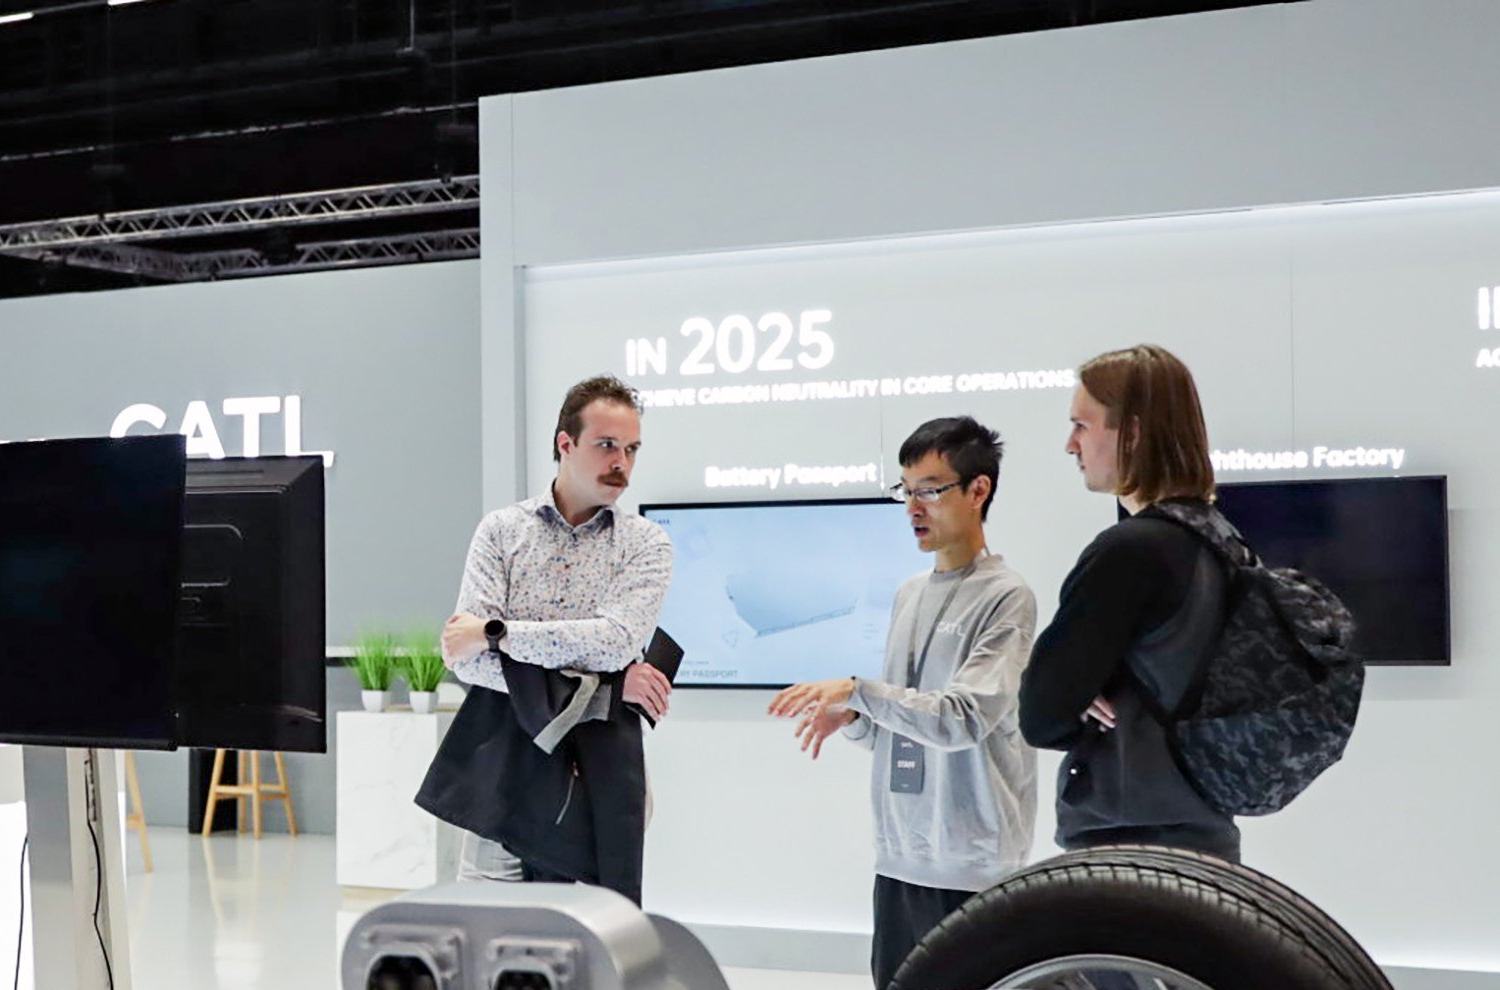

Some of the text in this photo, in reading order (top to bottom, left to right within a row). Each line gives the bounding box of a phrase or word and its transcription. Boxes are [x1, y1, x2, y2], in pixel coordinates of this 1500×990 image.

[625, 309, 835, 376] IN 2025
[698, 384, 770, 404] CARBON
[771, 379, 879, 402] NEUTRALITY
[880, 378, 901, 396] IN
[903, 374, 954, 395] CORE
[956, 369, 1077, 391] OPERATIONS
[1312, 446, 1405, 469] Factory
[704, 462, 878, 490] Battery Passport
